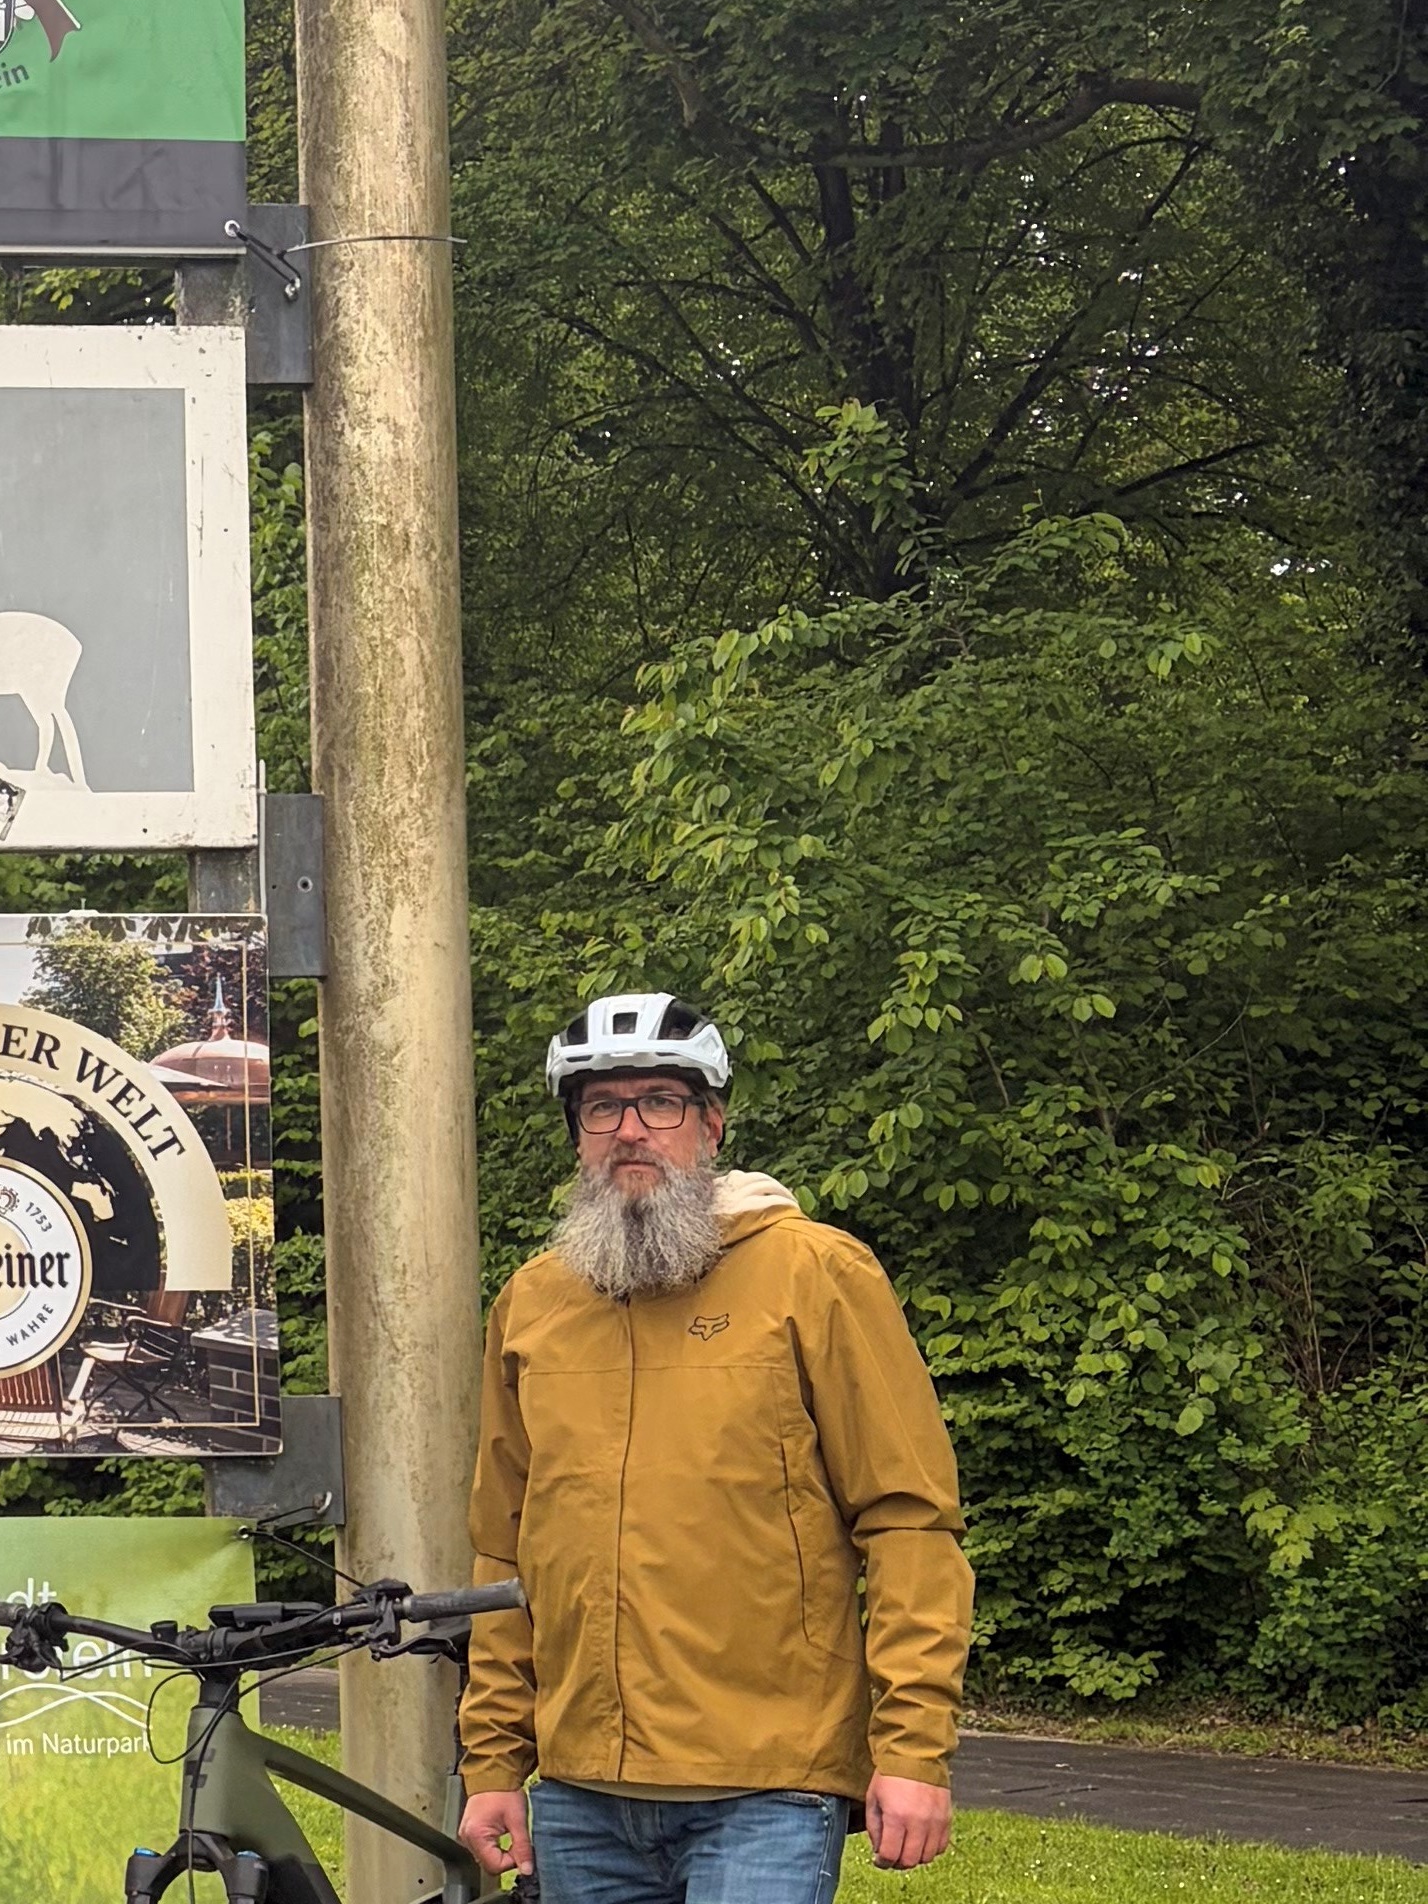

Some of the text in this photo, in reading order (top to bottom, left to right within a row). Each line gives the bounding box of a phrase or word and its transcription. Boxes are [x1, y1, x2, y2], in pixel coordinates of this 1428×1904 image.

[74, 1045, 186, 1162] WELT
[24, 1201, 53, 1233] 1753
[5, 1302, 54, 1347] WAHRE
[6, 1732, 35, 1755] im
